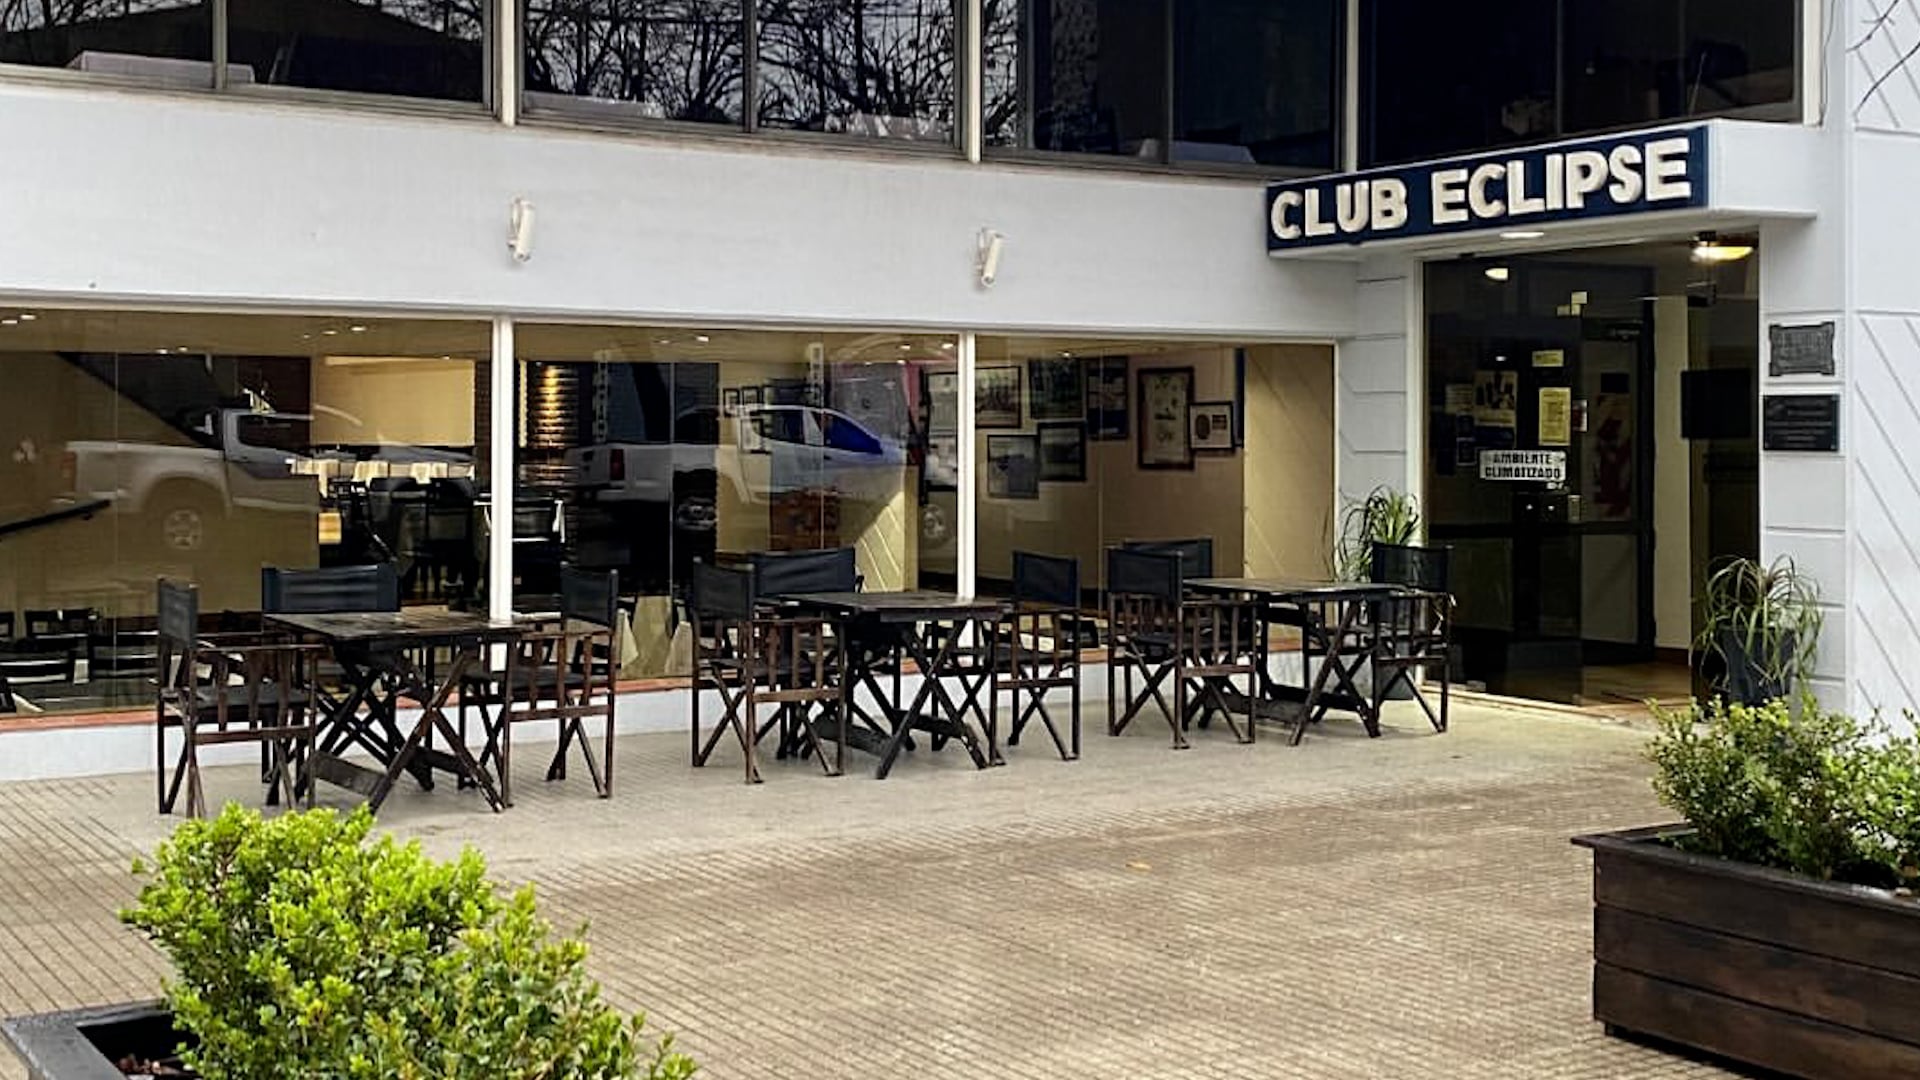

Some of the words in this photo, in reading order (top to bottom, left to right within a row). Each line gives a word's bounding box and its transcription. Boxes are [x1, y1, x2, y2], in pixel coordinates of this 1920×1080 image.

[1270, 178, 1407, 240] CLUB
[1431, 137, 1691, 225] ECLIPSE
[1493, 453, 1551, 464] AMBIENTE
[1485, 466, 1560, 478] CLIMATIZADO
